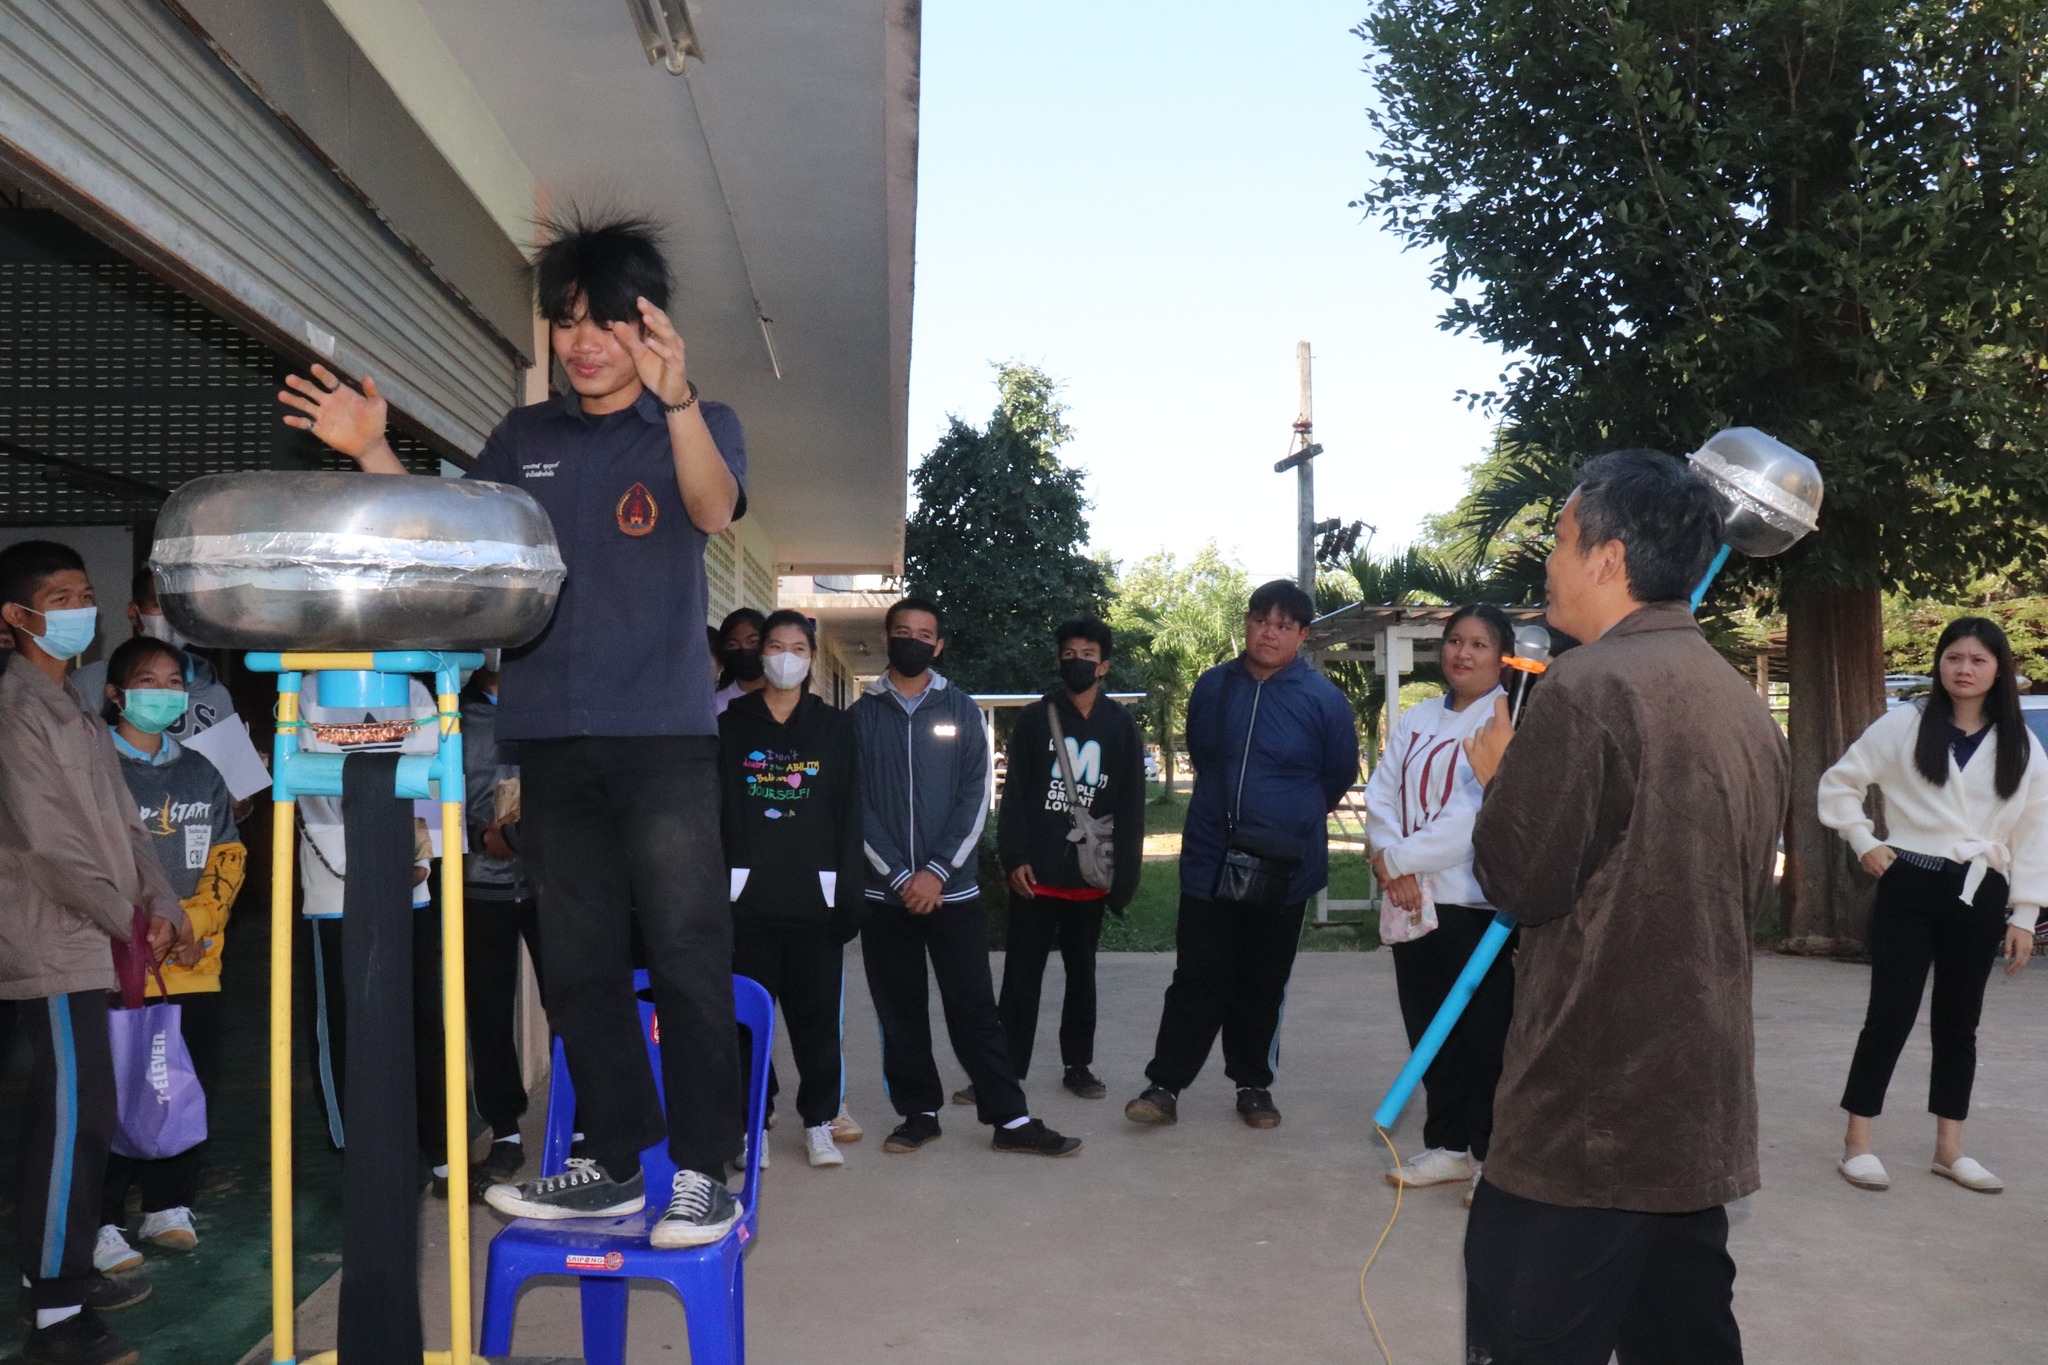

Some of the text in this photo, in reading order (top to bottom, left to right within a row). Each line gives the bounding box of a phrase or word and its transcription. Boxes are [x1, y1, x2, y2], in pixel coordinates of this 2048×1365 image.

[1049, 779, 1096, 798] COPLE
[1044, 799, 1076, 815] LOV
[1047, 790, 1094, 808] GRNT
